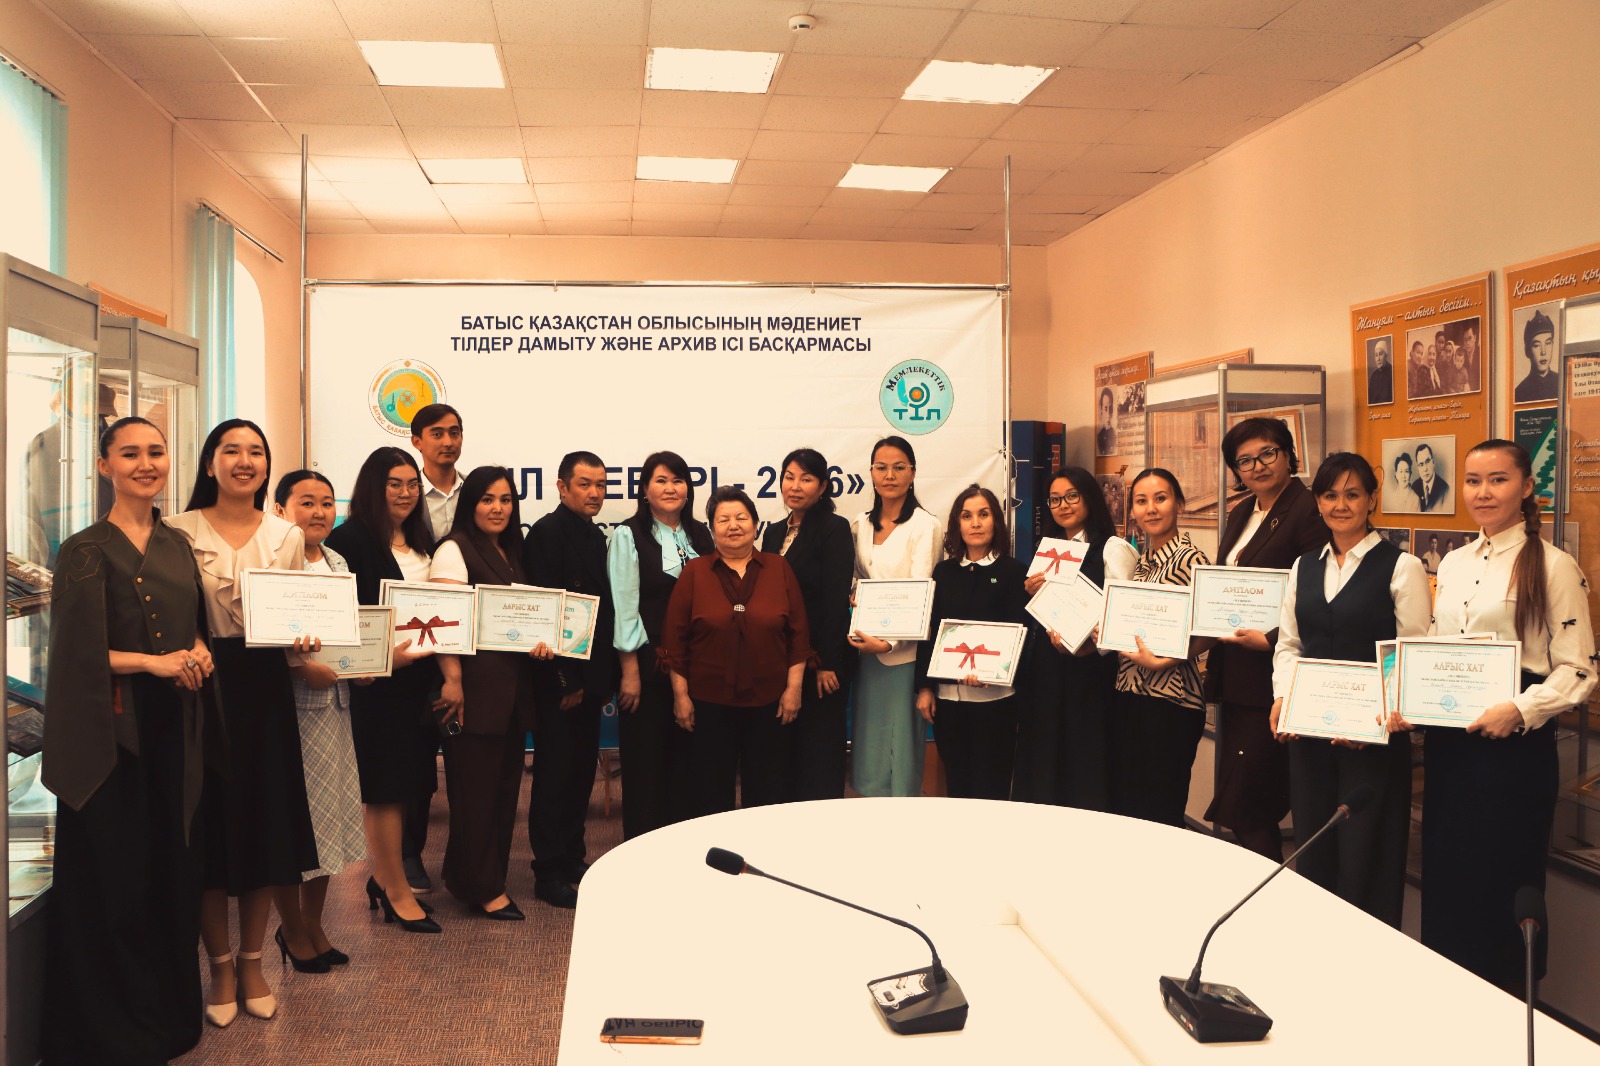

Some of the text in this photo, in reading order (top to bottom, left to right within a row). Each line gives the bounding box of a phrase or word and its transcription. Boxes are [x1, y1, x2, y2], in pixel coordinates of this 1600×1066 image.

[1512, 273, 1577, 299] Қазақтың
[1404, 306, 1436, 321] алтын
[461, 315, 862, 333] БАТЫС ҚАЗАҚСТАН ОБЛЫСЫНЫҢ МӘДЕНИЕТ
[450, 336, 872, 354] ТІЛДЕР ДАМЫТУ ЖӘНЕ АРХИВ ІСІ БАСҚАРМАСЫ
[386, 424, 411, 436] ҚАЗАҚС
[756, 465, 865, 499] 26»
[1222, 586, 1265, 595] ДИПЛОМ
[1466, 663, 1485, 673] ХАТ
